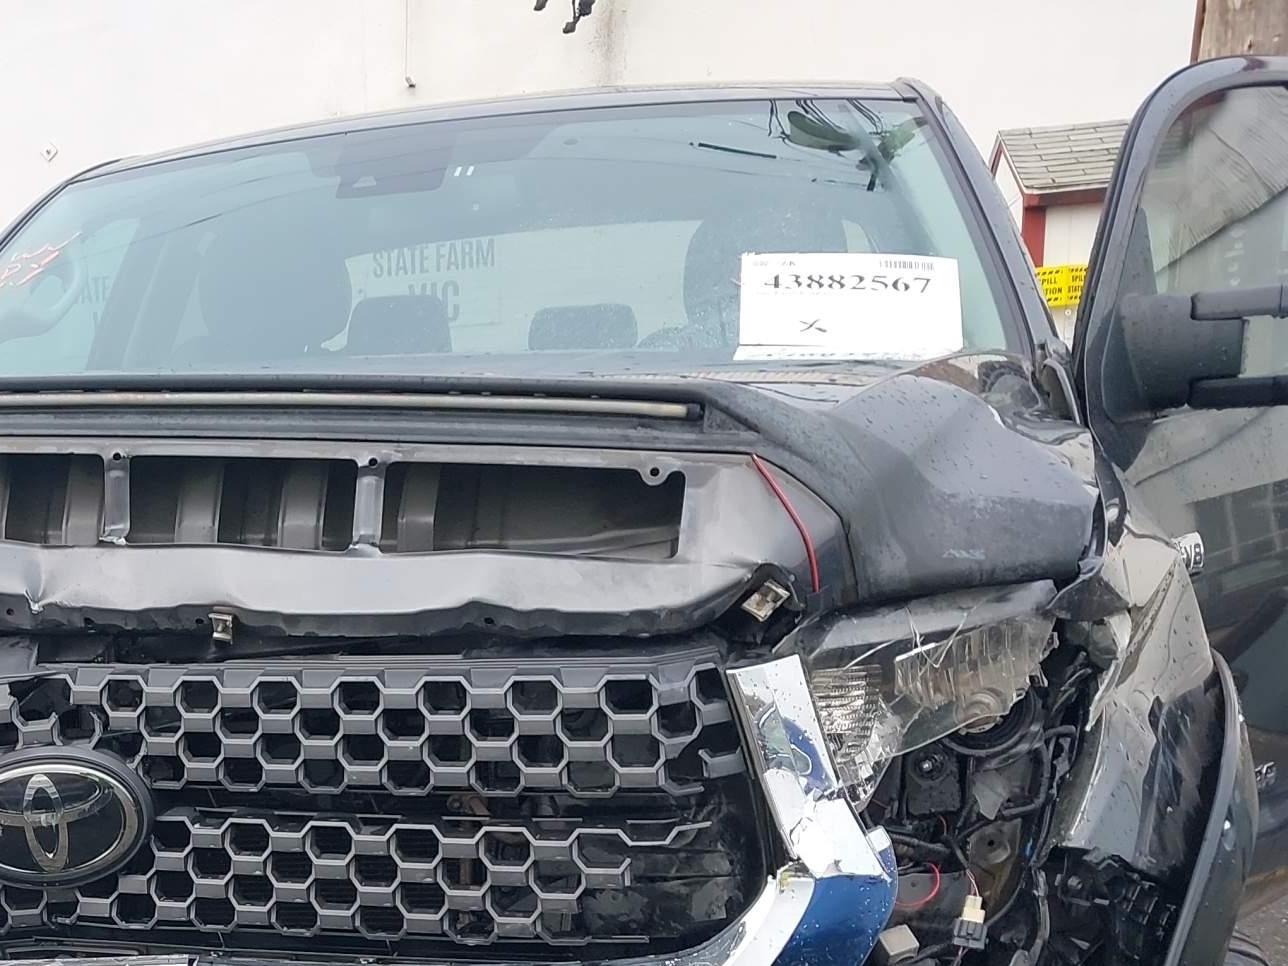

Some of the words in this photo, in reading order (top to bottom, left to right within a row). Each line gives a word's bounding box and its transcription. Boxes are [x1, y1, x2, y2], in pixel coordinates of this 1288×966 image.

[372, 246, 429, 278] STATE
[436, 238, 495, 272] FARM
[763, 272, 931, 294] 43882567
